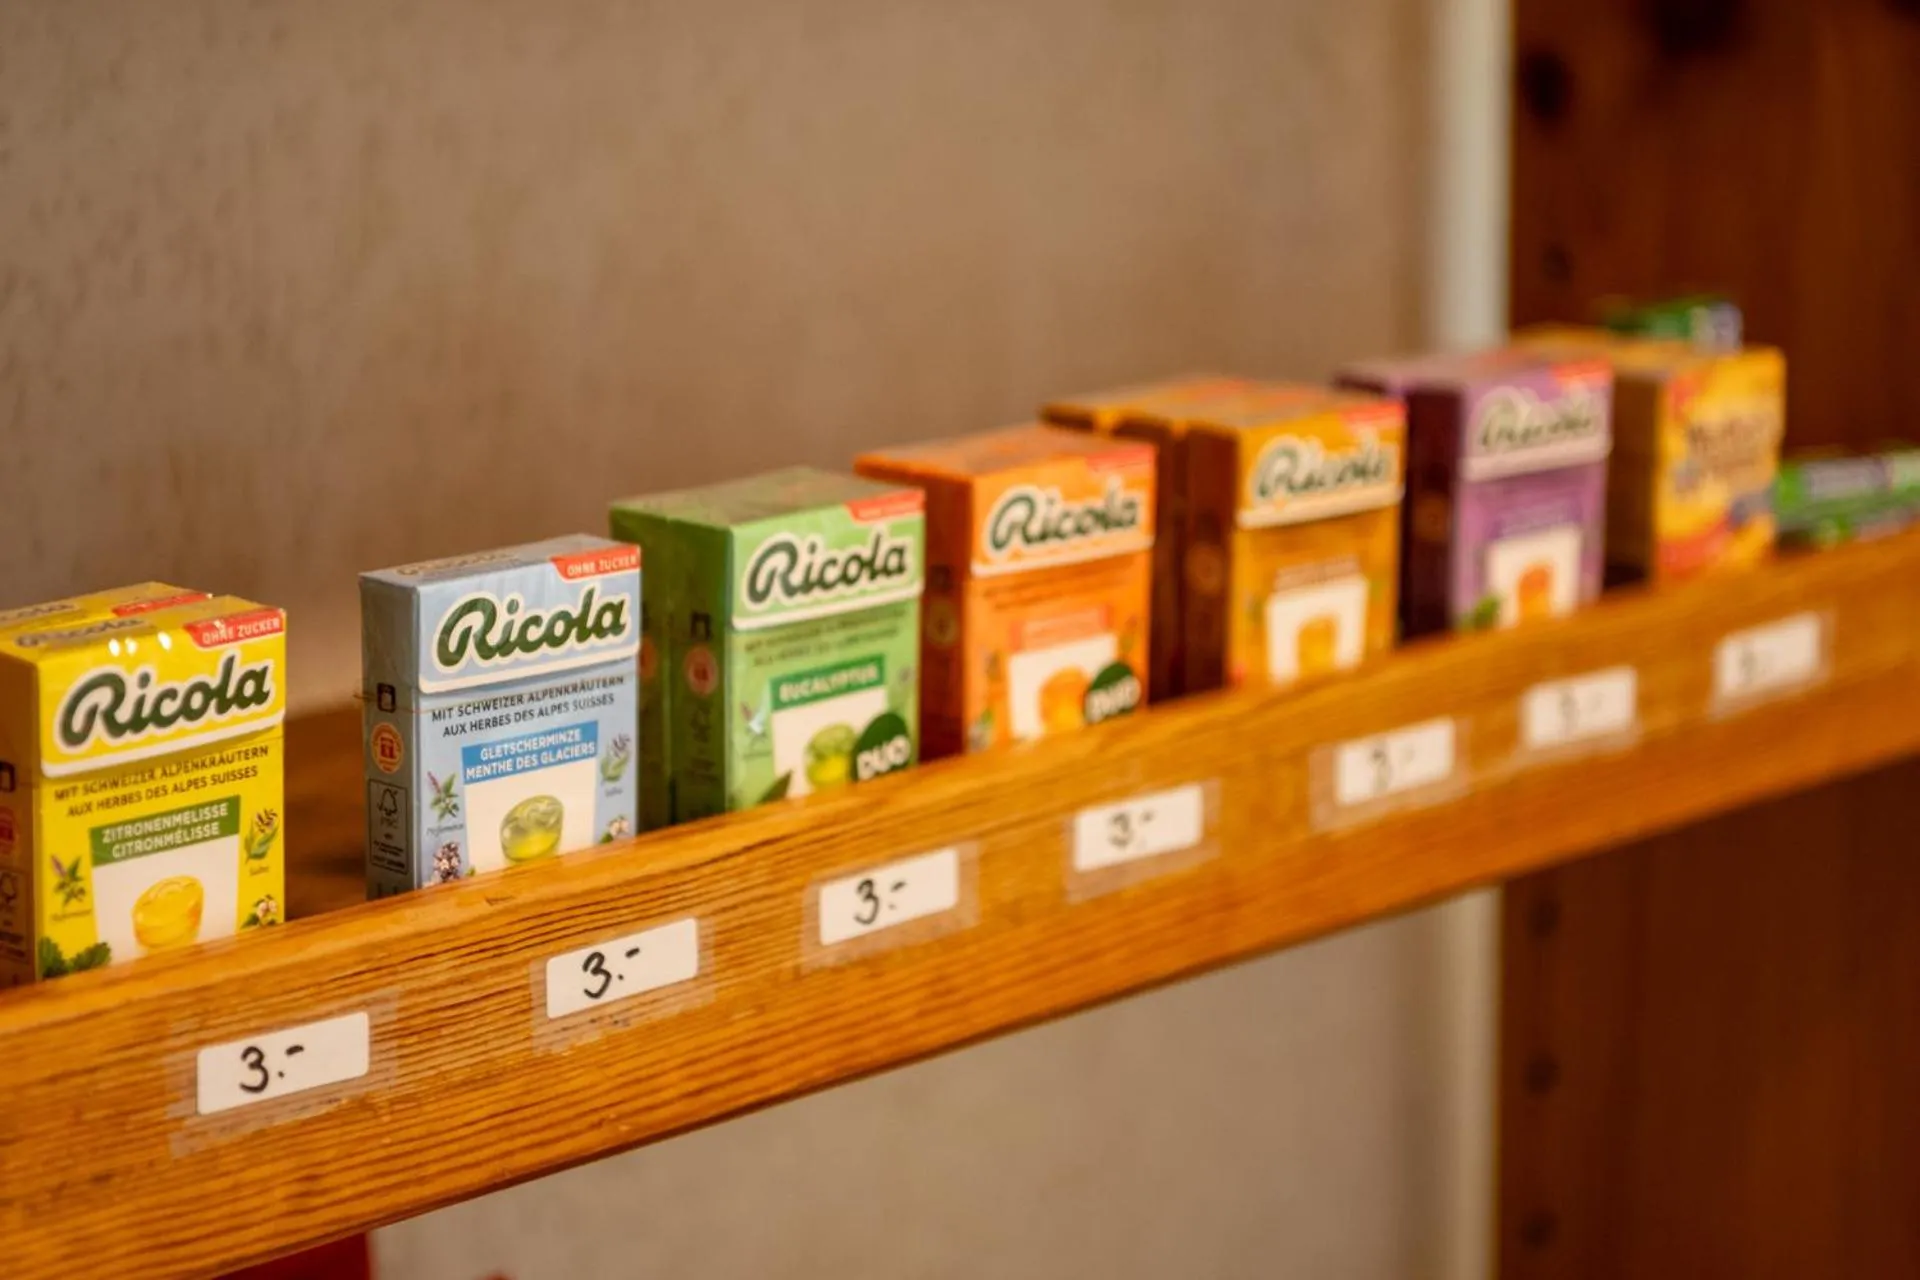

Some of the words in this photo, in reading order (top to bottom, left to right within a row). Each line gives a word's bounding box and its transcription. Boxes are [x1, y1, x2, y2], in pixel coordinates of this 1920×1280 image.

[990, 485, 1138, 551] Ricola
[566, 562, 596, 577] OHNE
[598, 556, 638, 572] ZUCKER
[749, 534, 907, 604] Ricola
[201, 626, 235, 644] OHNE
[236, 617, 281, 638] ZUCKER
[436, 586, 628, 667] Ricola
[60, 655, 272, 748] Ricola
[432, 707, 454, 722] MIT
[457, 694, 524, 717] SCHWEIZER
[526, 675, 625, 704] ALPENKRÄUTERN
[442, 723, 468, 738] AUX
[470, 714, 511, 733] HERBES
[514, 709, 535, 723] DES
[537, 704, 569, 718] ALPES
[572, 692, 615, 712] SUISSES
[465, 760, 513, 781] MENTHE
[516, 755, 539, 769] DES
[540, 741, 596, 766] GLACIERS
[480, 728, 582, 761] GLETSCHERMINZE
[857, 734, 911, 780] DUO
[54, 786, 78, 801] MIT
[82, 768, 155, 796] SCHWEIZER
[67, 802, 94, 817] AUX
[96, 791, 143, 811] HERBES
[145, 785, 169, 800] DES
[173, 778, 207, 794] ALPES
[210, 765, 258, 785] SUISSES
[102, 802, 229, 843] ZITRONENMELISSE
[854, 878, 908, 925] 3.-
[582, 947, 640, 999] 3.-
[239, 1045, 304, 1093] 3.-
